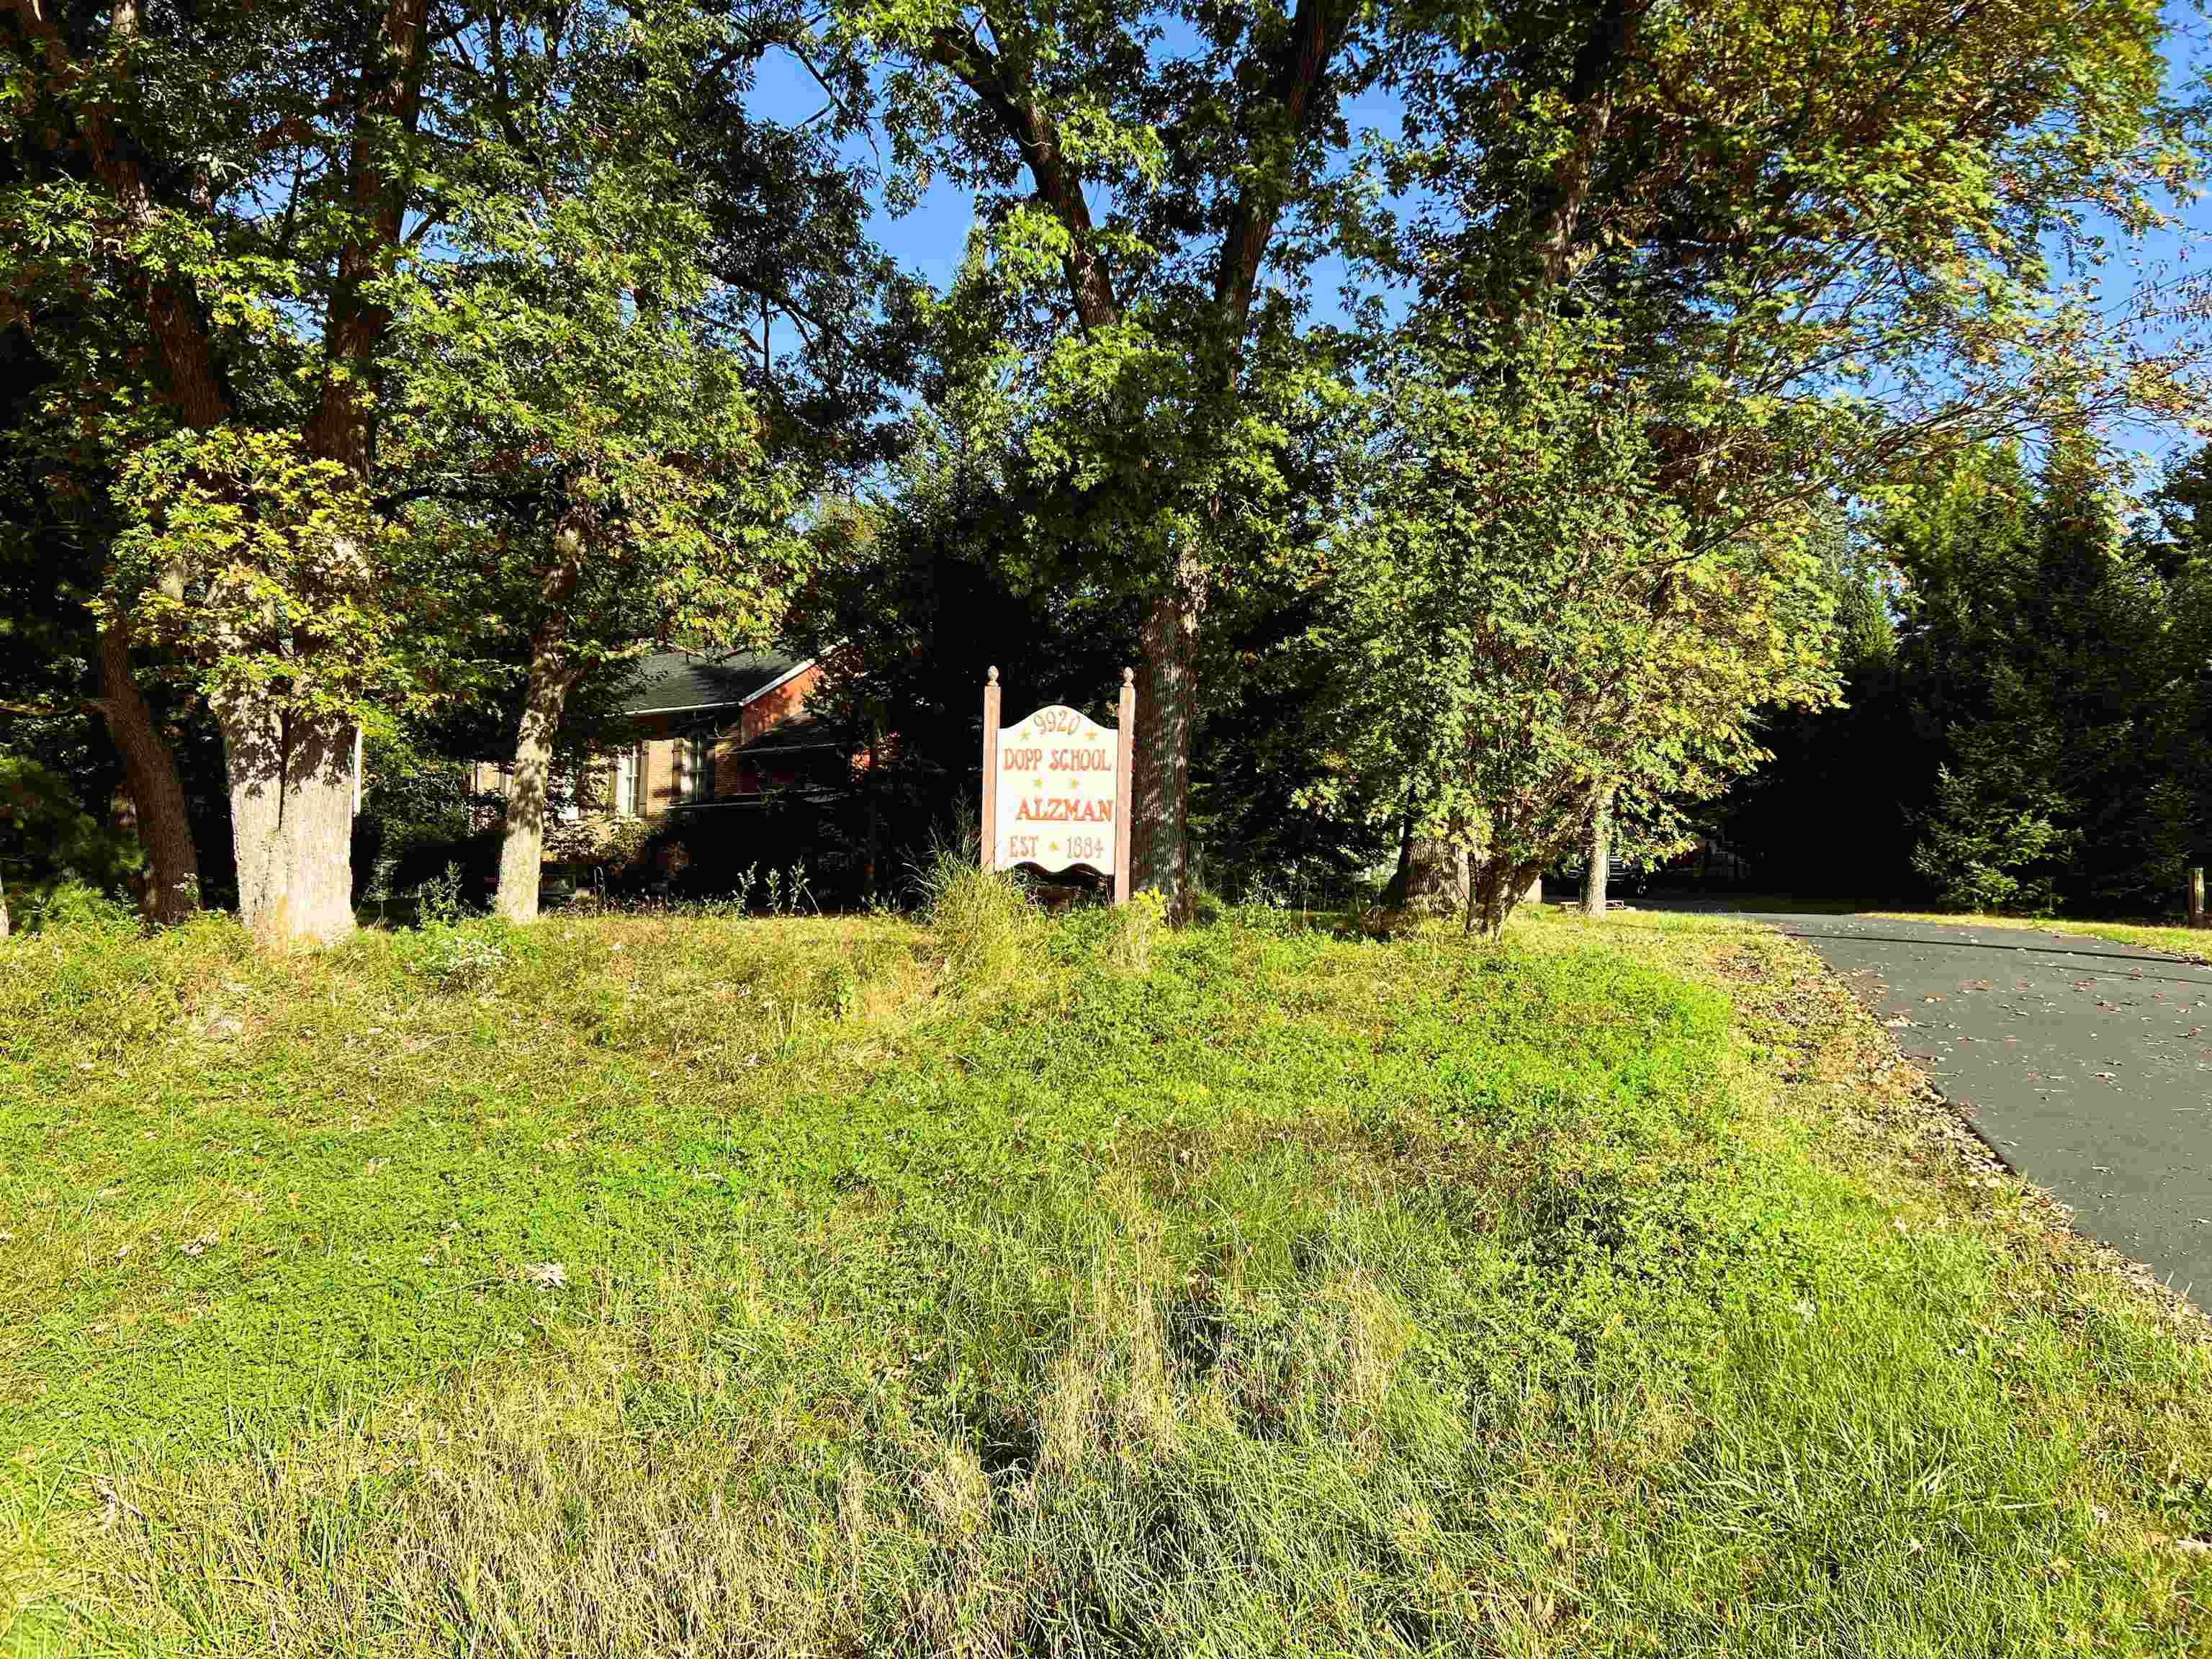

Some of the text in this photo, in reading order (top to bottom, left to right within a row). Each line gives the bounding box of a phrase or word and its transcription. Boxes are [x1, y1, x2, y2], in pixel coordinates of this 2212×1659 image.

[1033, 710, 1081, 734] 9920
[1002, 748, 1112, 772] DOPP SCHOOL
[1016, 797, 1113, 822] ALZMAN
[1009, 835, 1038, 858] EST
